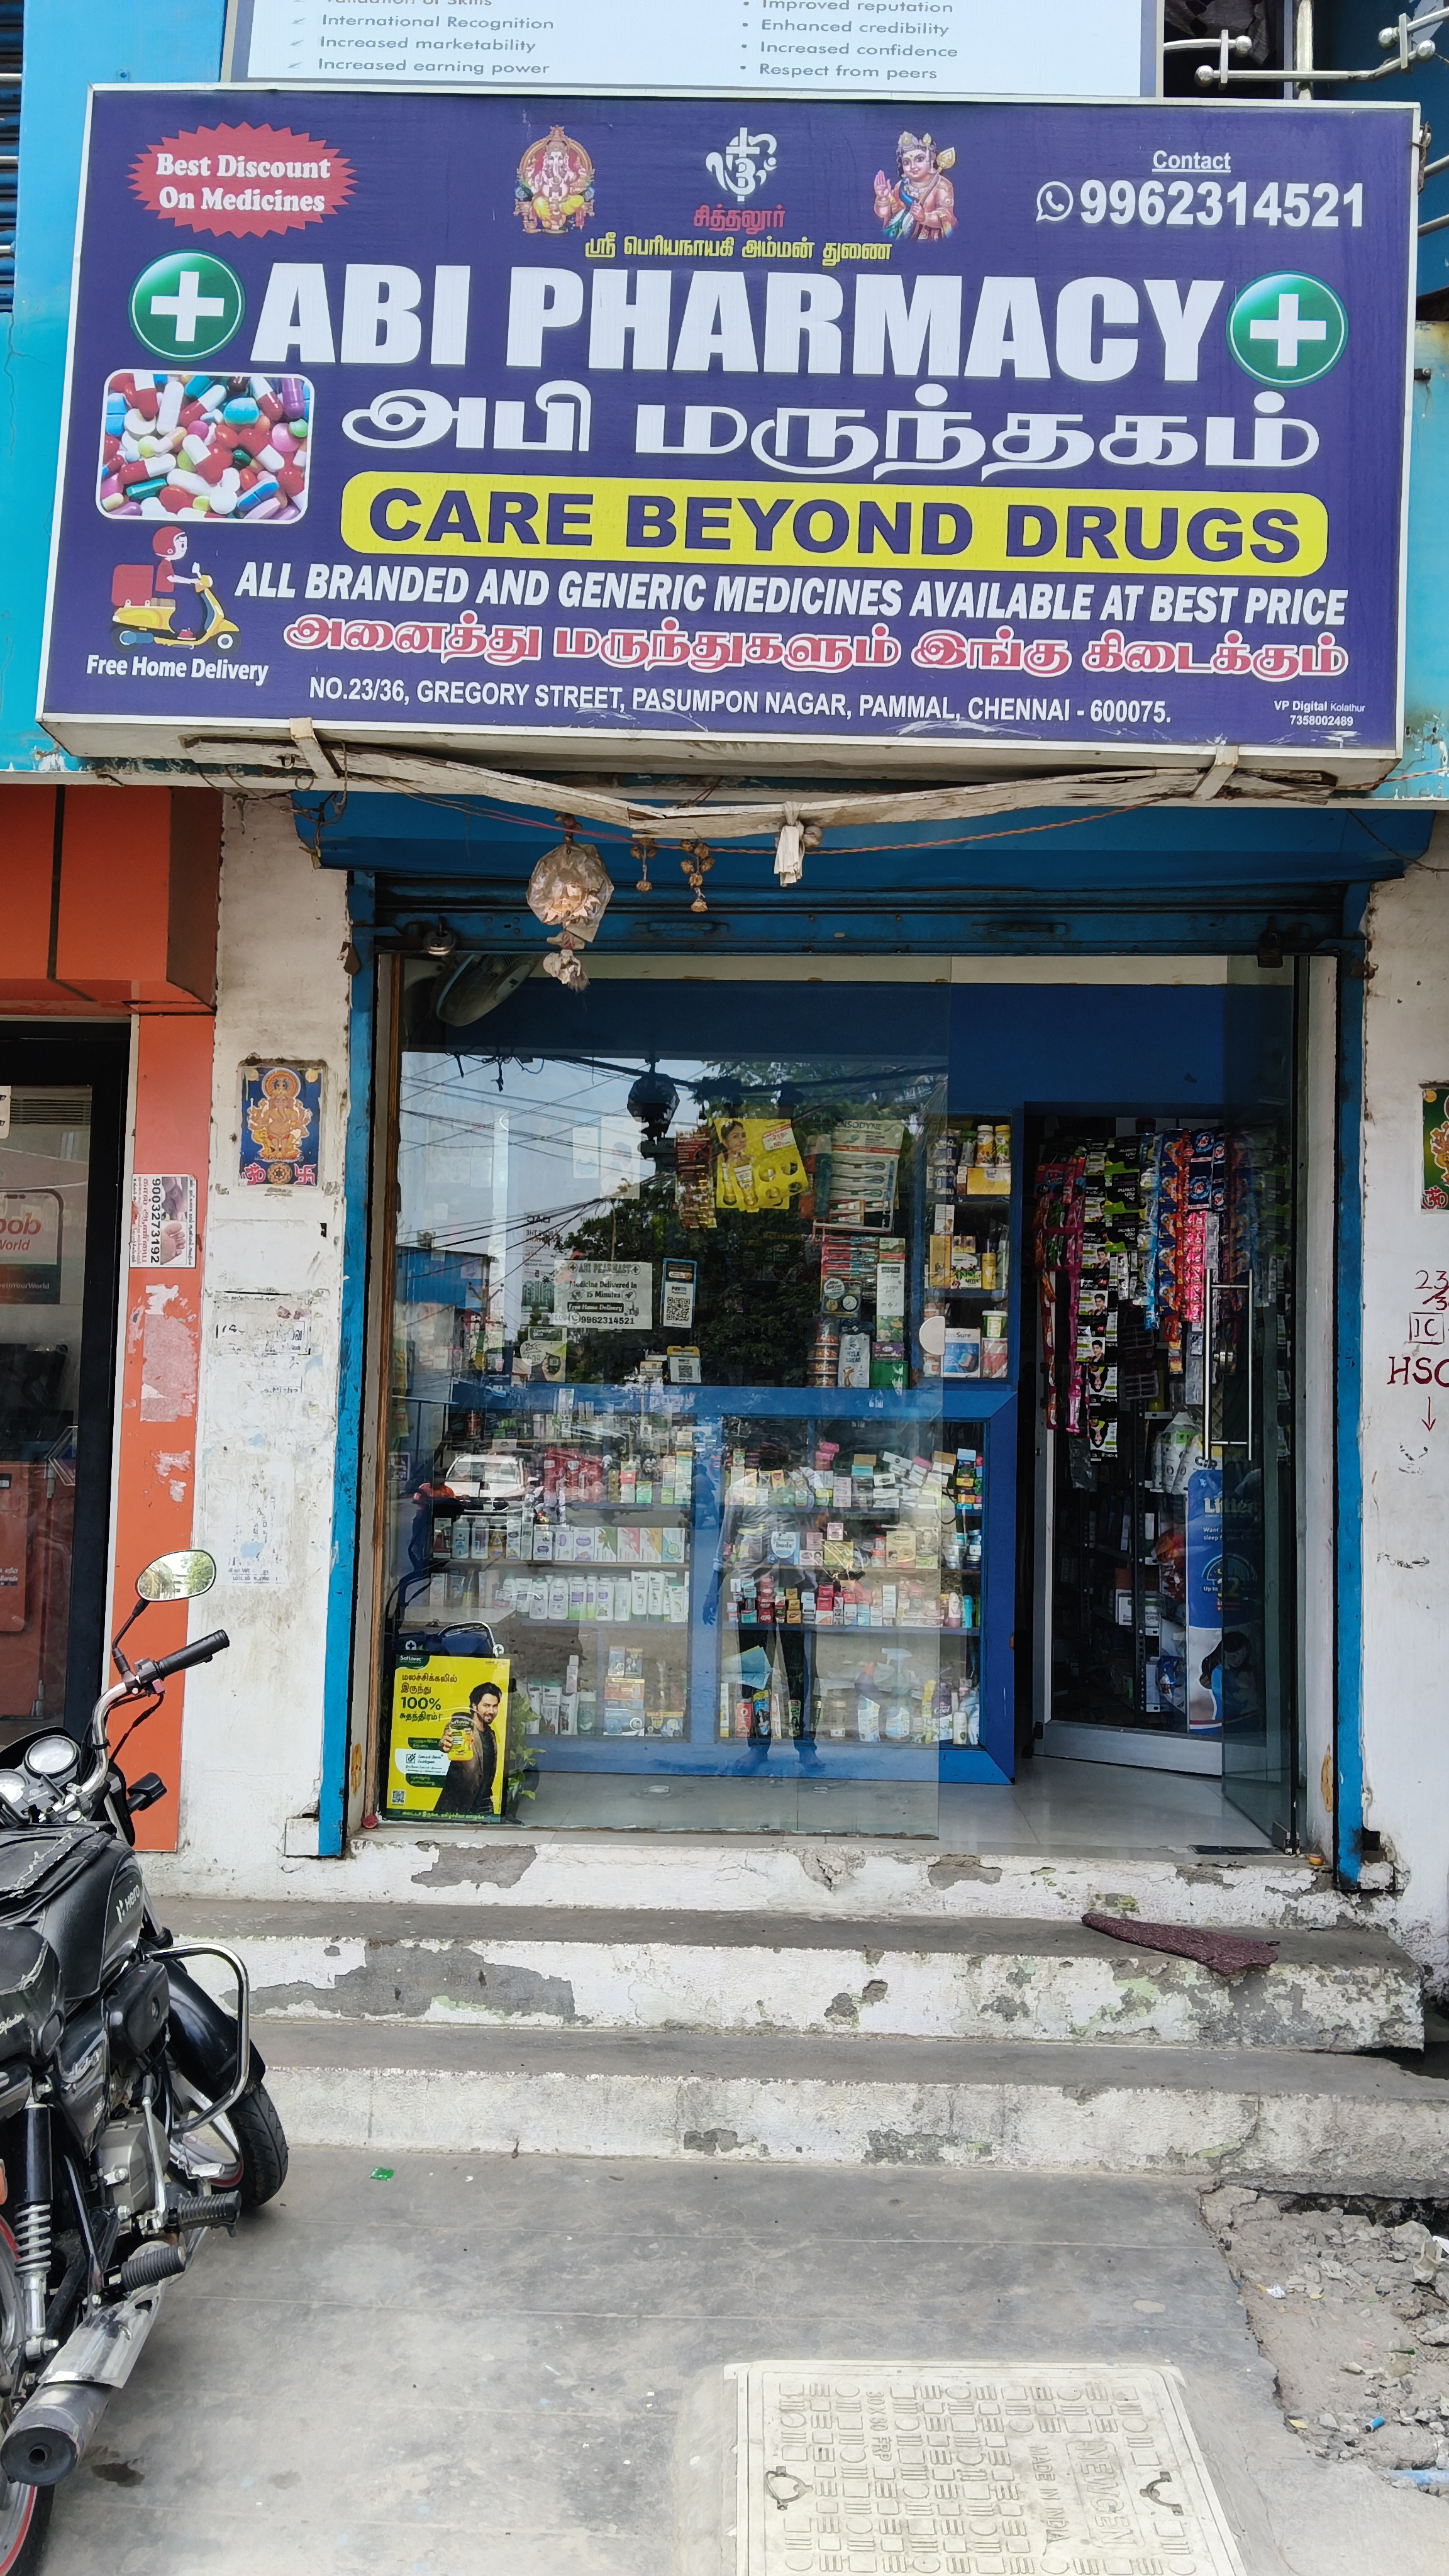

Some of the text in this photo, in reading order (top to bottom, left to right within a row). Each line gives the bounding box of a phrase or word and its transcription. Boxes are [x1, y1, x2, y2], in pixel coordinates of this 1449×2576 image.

[857, 1, 953, 14] reputation
[322, 14, 553, 31] International Recognition
[762, 19, 950, 36] Enhanced credibility
[320, 36, 536, 54] Increased marketability
[760, 42, 958, 57] Increased confidence
[318, 58, 550, 75] Increased earning power
[760, 64, 938, 80] Respect from peers
[157, 153, 331, 179] Best Discount
[1152, 150, 1231, 170] Contact
[160, 186, 325, 213] On Medicines
[1080, 180, 1363, 228] 9962314521
[693, 204, 786, 234] சித்தலூர்
[585, 231, 892, 267] ஸ்ரீ பெரியநாயகி அம்மன் துணை
[250, 263, 1225, 382] ABI PHARMACY
[341, 379, 1320, 481] அபி மருந்தகம்
[369, 488, 1300, 564] CARE BEYOND DRUGS
[235, 562, 1348, 625] ALL BRANDED AND GENERIC MEDICINES AVAILABLE AT BEST PRICE
[284, 610, 1348, 682] அனைத்து மருந்துகளும் இங்கு கிடைக்கும்
[87, 655, 269, 686] Free Home Delivery
[309, 676, 409, 704] NO.23/36,
[416, 680, 530, 706] GREGORY
[535, 684, 625, 713] STREET,
[632, 687, 756, 714] PASUMPON
[764, 692, 852, 719] NAGAR,
[859, 695, 960, 721] PAMMAL,
[968, 697, 1070, 721] CHENNAI
[1090, 699, 1172, 723] 600075.
[1274, 699, 1365, 714] VP Digital Kolathur
[1290, 714, 1353, 727] 7358002489
[836, 1121, 883, 1131] NSODYNE
[143, 1178, 152, 1205] கால்
[150, 1179, 161, 1263] 9003273192
[580, 1316, 635, 1324] 9962314521
[401, 1682, 432, 1695] இருந்து
[402, 1672, 458, 1683] மலச்சிக்கலில்
[401, 1696, 441, 1711] 100%
[125, 1884, 140, 1912] Hero
[1028, 2446, 1055, 2482] MADE
[1039, 2488, 1061, 2501] IN
[1076, 2445, 1135, 2545] NEWGEN
